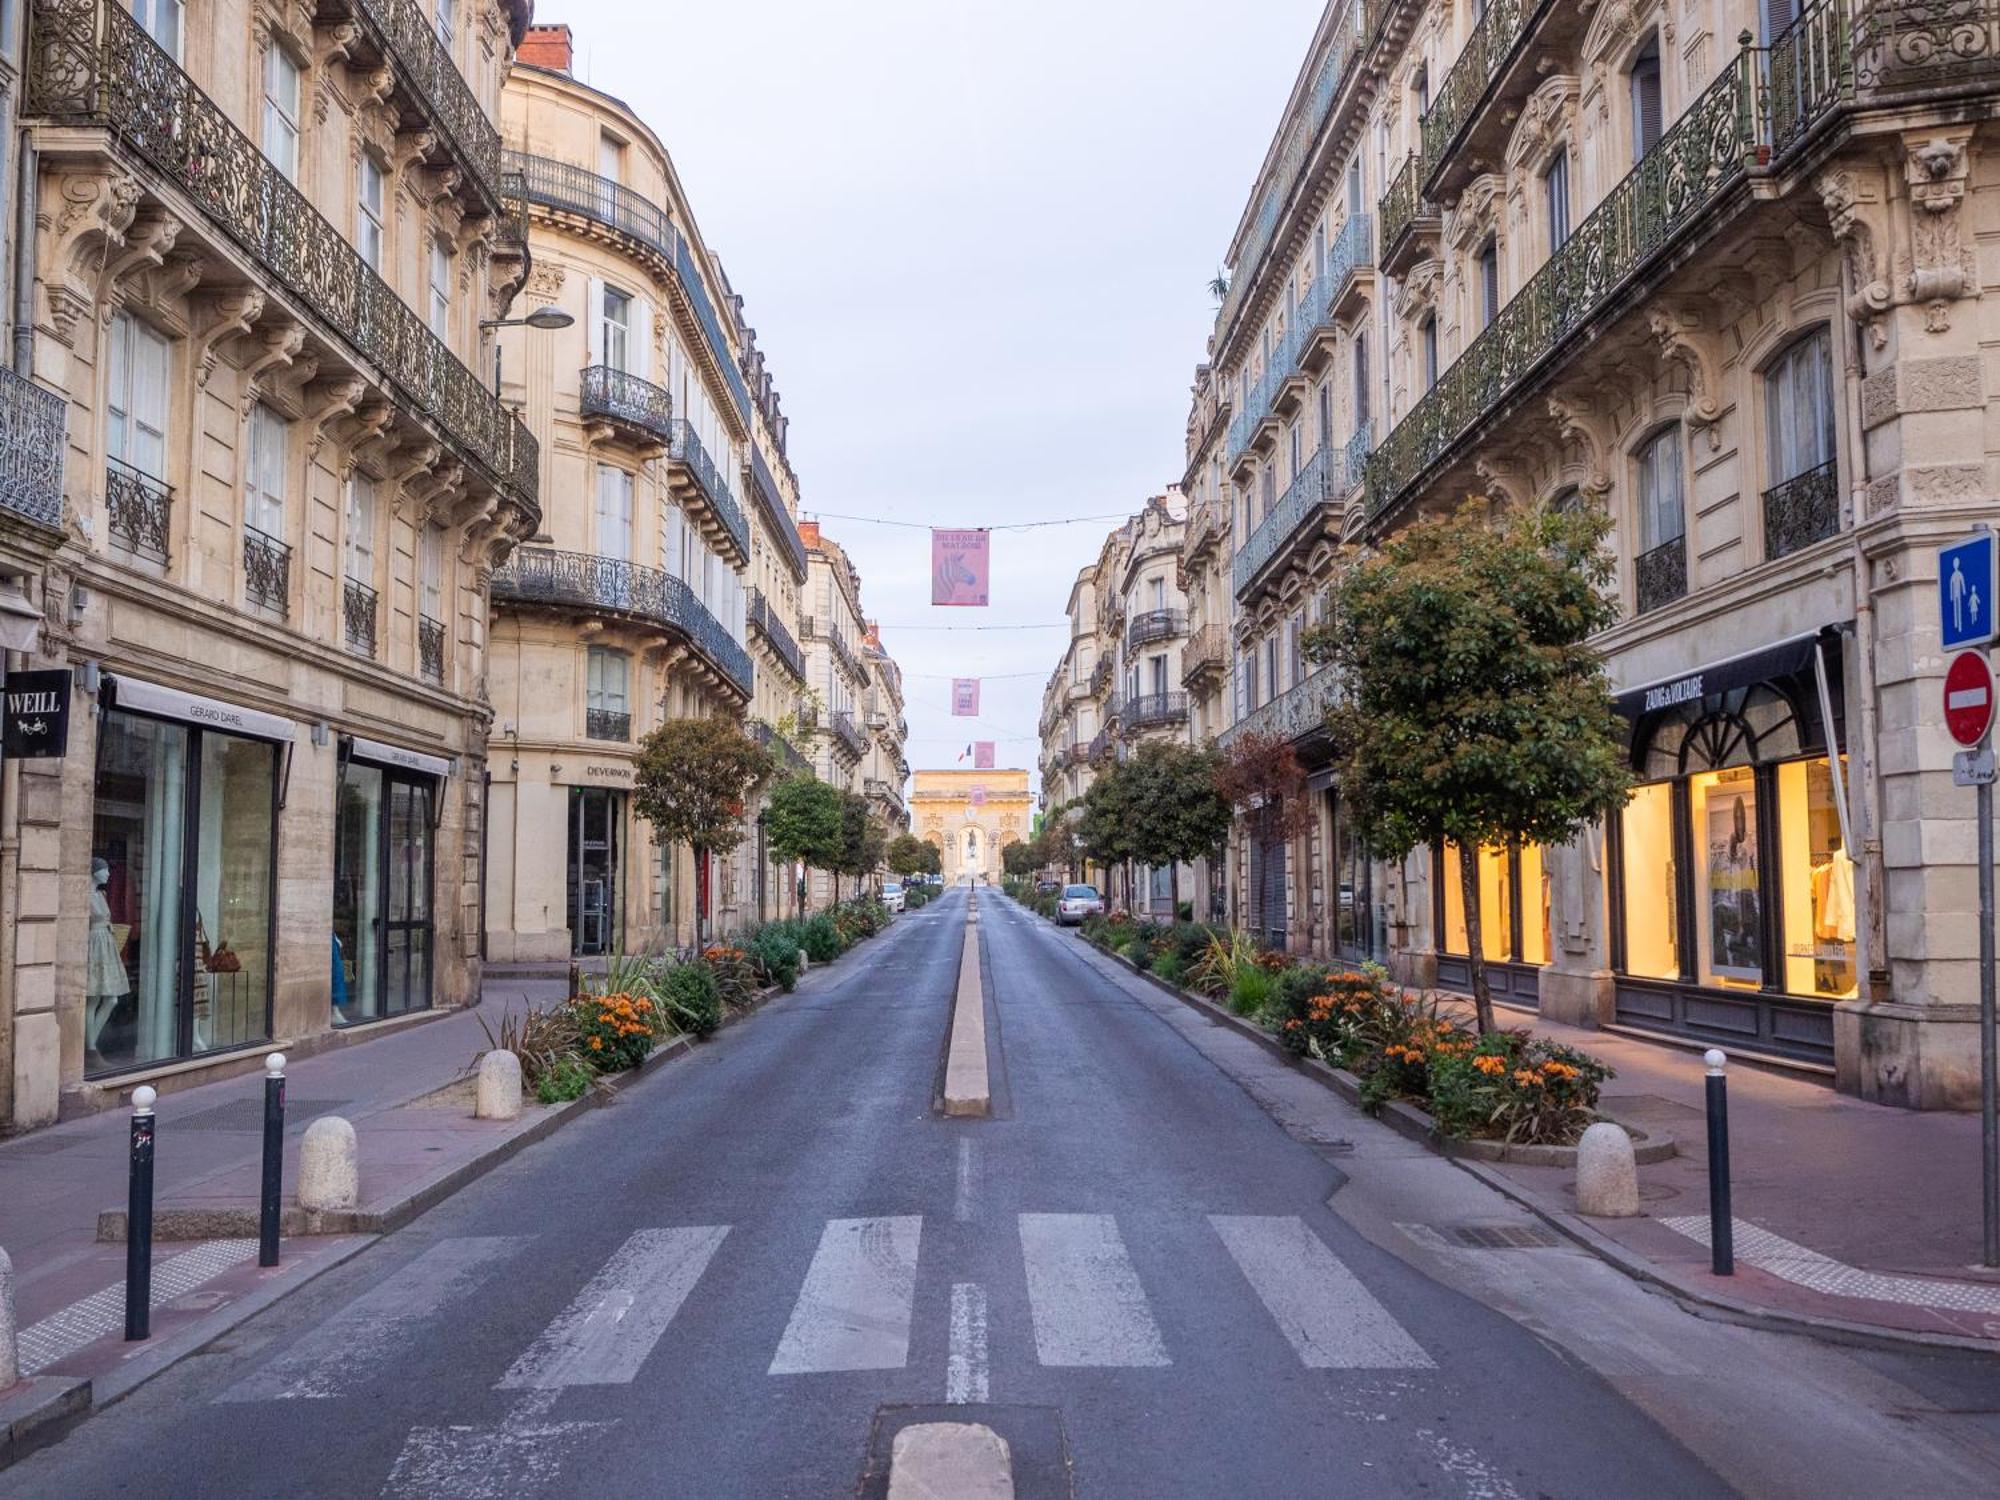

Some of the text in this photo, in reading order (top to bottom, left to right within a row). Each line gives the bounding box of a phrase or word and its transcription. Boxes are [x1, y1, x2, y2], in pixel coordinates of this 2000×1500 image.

[8, 691, 61, 714] WEILL
[1645, 675, 1703, 711] ZADIG&VOLTAIRE
[190, 705, 243, 726] GÉRARD DAREL
